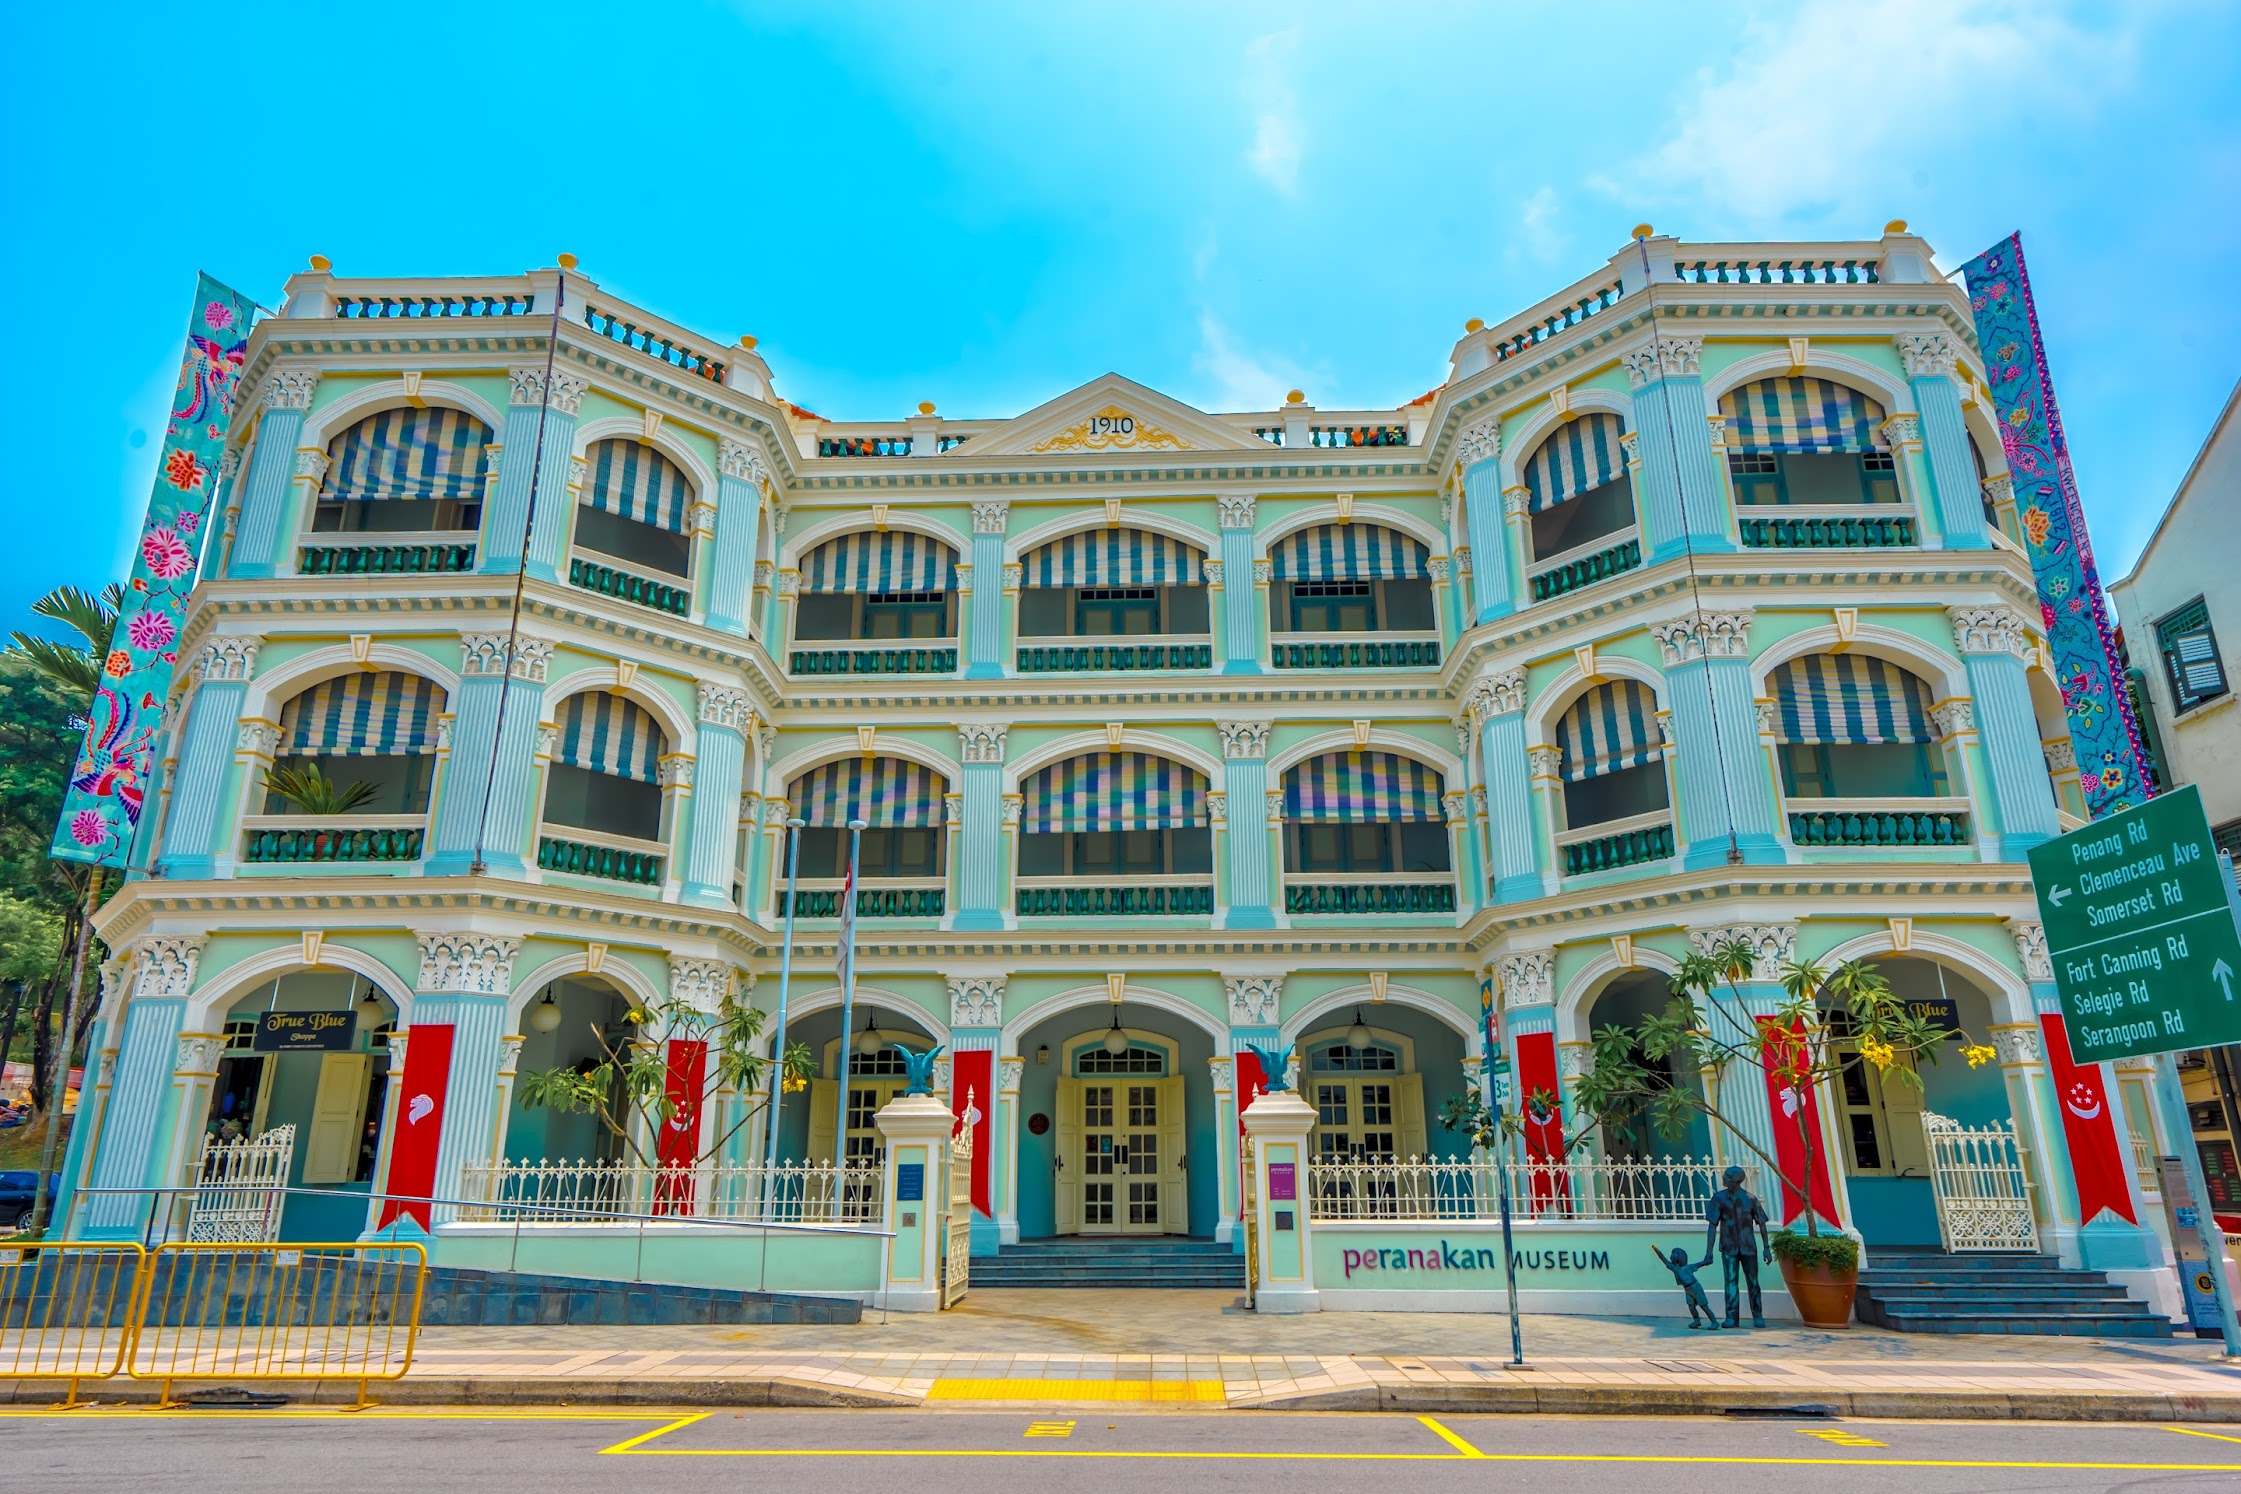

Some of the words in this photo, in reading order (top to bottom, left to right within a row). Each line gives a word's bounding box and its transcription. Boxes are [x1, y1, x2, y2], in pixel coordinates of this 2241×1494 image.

[1090, 417, 1134, 434] 1910
[2049, 500, 2067, 534] 1912
[2071, 838, 2123, 865] Penang
[2127, 818, 2148, 844] Rd
[2079, 853, 2166, 896] Clemenceau
[2173, 842, 2201, 867] Ave
[2086, 892, 2156, 927] Somerset
[2161, 879, 2184, 906] Rd
[2066, 958, 2097, 984] Fort
[2101, 945, 2162, 976] Canning
[2166, 933, 2189, 960] Rd
[1908, 1002, 1949, 1019] Blue
[2074, 986, 2124, 1016] Selegie
[2128, 979, 2150, 1005] Rd
[267, 1013, 306, 1031] True
[308, 1013, 347, 1031] Blue
[2081, 1018, 2158, 1048] Serangoon
[2162, 1008, 2185, 1036] Rd
[1343, 1240, 1495, 1278] peranakan
